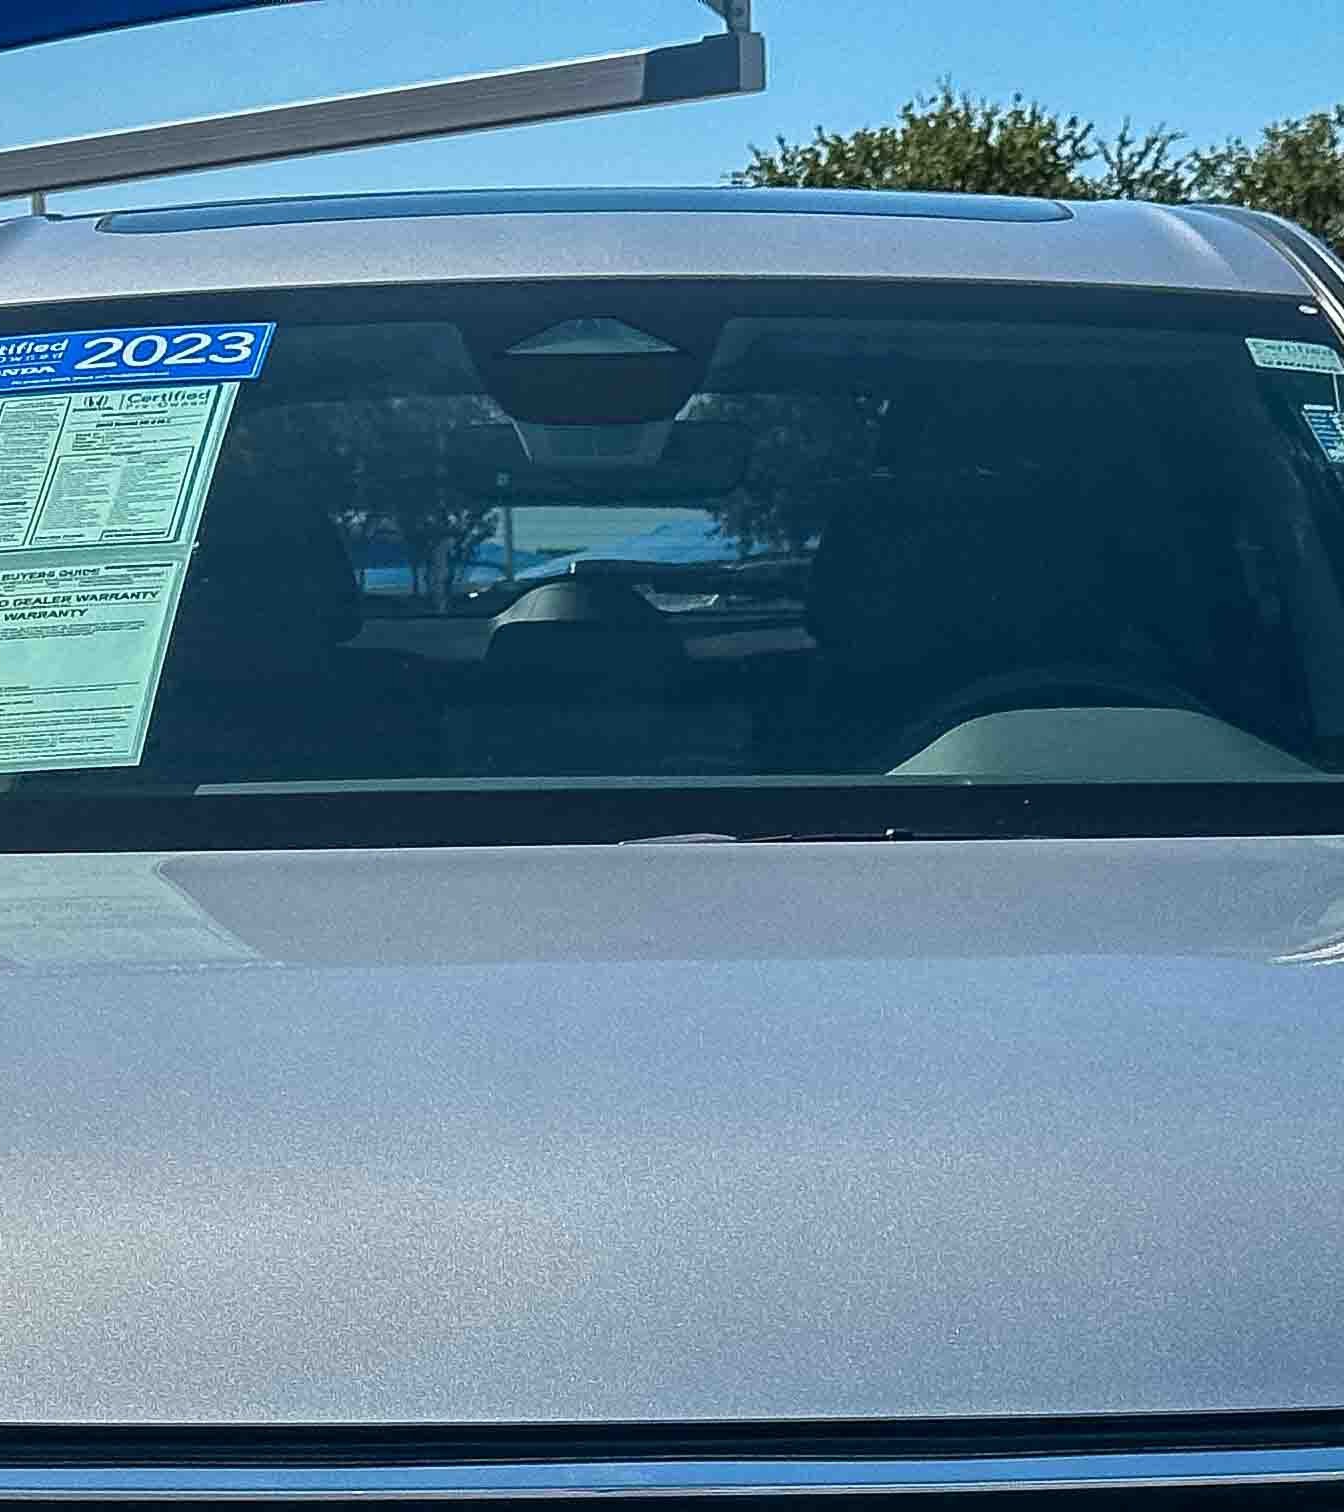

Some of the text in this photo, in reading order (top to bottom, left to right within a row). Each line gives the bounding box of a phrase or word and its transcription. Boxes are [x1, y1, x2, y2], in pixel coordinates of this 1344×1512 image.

[74, 331, 256, 370] 2023
[13, 594, 72, 608] DEALER
[76, 590, 159, 603] WARRANTY
[4, 608, 88, 622] WARRANTY
